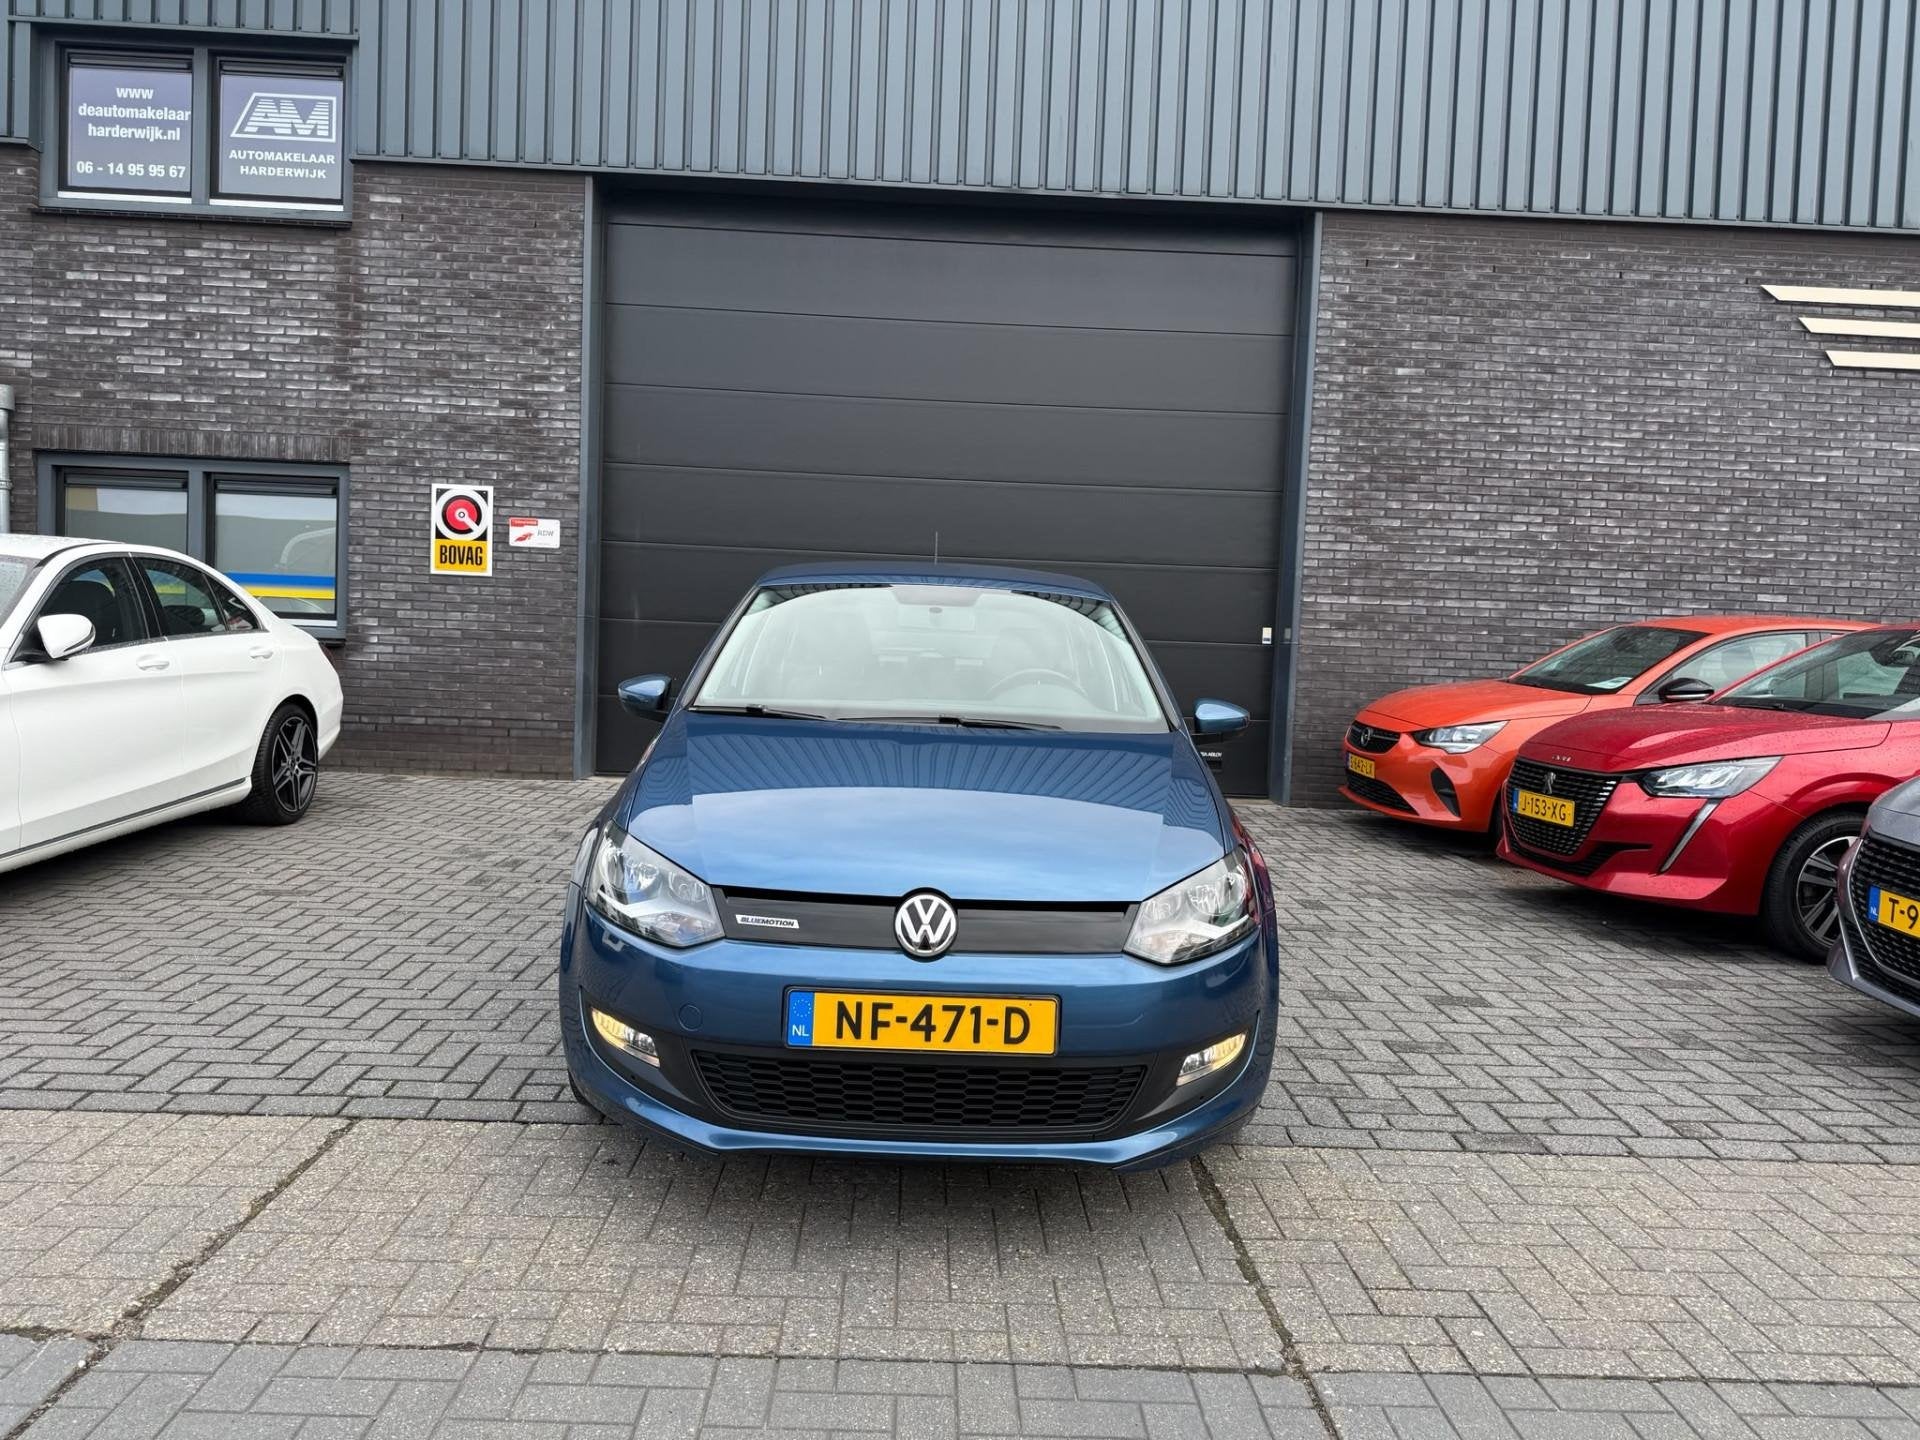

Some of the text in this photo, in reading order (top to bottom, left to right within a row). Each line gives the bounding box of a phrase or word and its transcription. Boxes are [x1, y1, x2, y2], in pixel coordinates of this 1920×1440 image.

[116, 87, 154, 100] www
[78, 103, 191, 122] deautomakelaar
[243, 98, 330, 137] AM
[88, 123, 181, 143] harderwijk.nl
[228, 149, 336, 165] AUTOMAKELAAR
[76, 161, 92, 175] 06
[108, 162, 124, 176] 14
[128, 163, 145, 177] 95
[150, 164, 166, 178] 95
[169, 165, 186, 179] 67
[240, 165, 327, 180] HARDERWIJK
[439, 544, 483, 566] BOVAG
[1521, 795, 1566, 821] J-153-XG
[740, 916, 795, 927] BLUEMOTION
[895, 893, 956, 956] VW
[791, 1025, 809, 1037] NL
[835, 1001, 1031, 1045] NF-471-D
